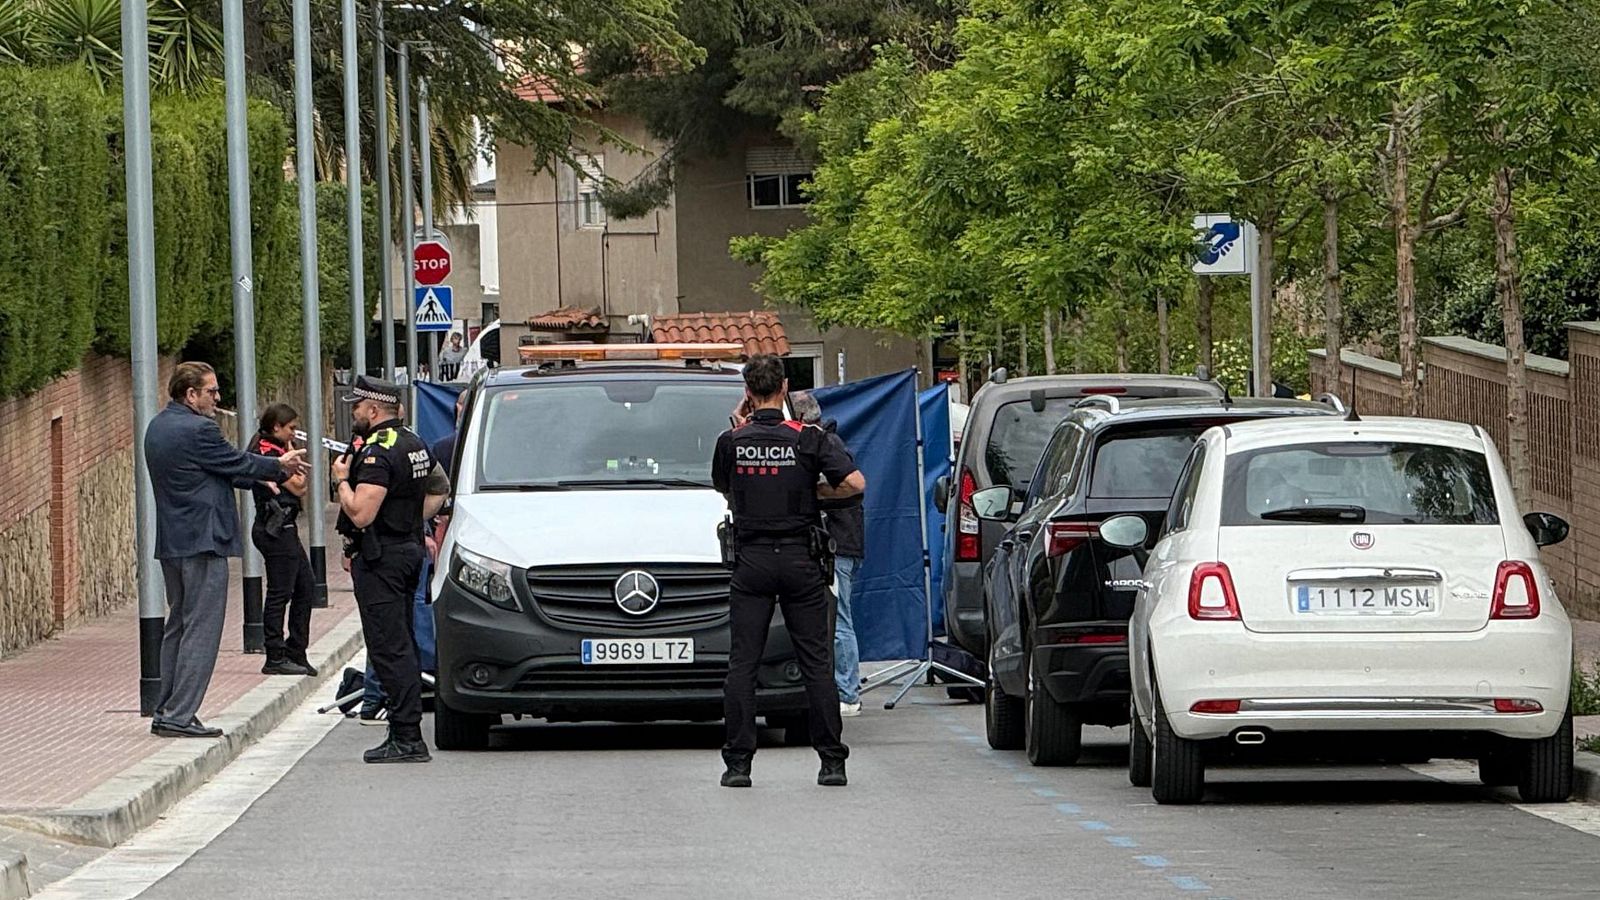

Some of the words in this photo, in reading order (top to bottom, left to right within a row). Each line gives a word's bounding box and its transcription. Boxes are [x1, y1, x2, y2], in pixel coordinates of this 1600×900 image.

[414, 258, 448, 271] STOP
[736, 446, 796, 459] POLICIA
[1317, 588, 1376, 608] 1112
[1384, 588, 1430, 608] MSM
[596, 642, 645, 660] 9969
[652, 642, 689, 660] LTZ
